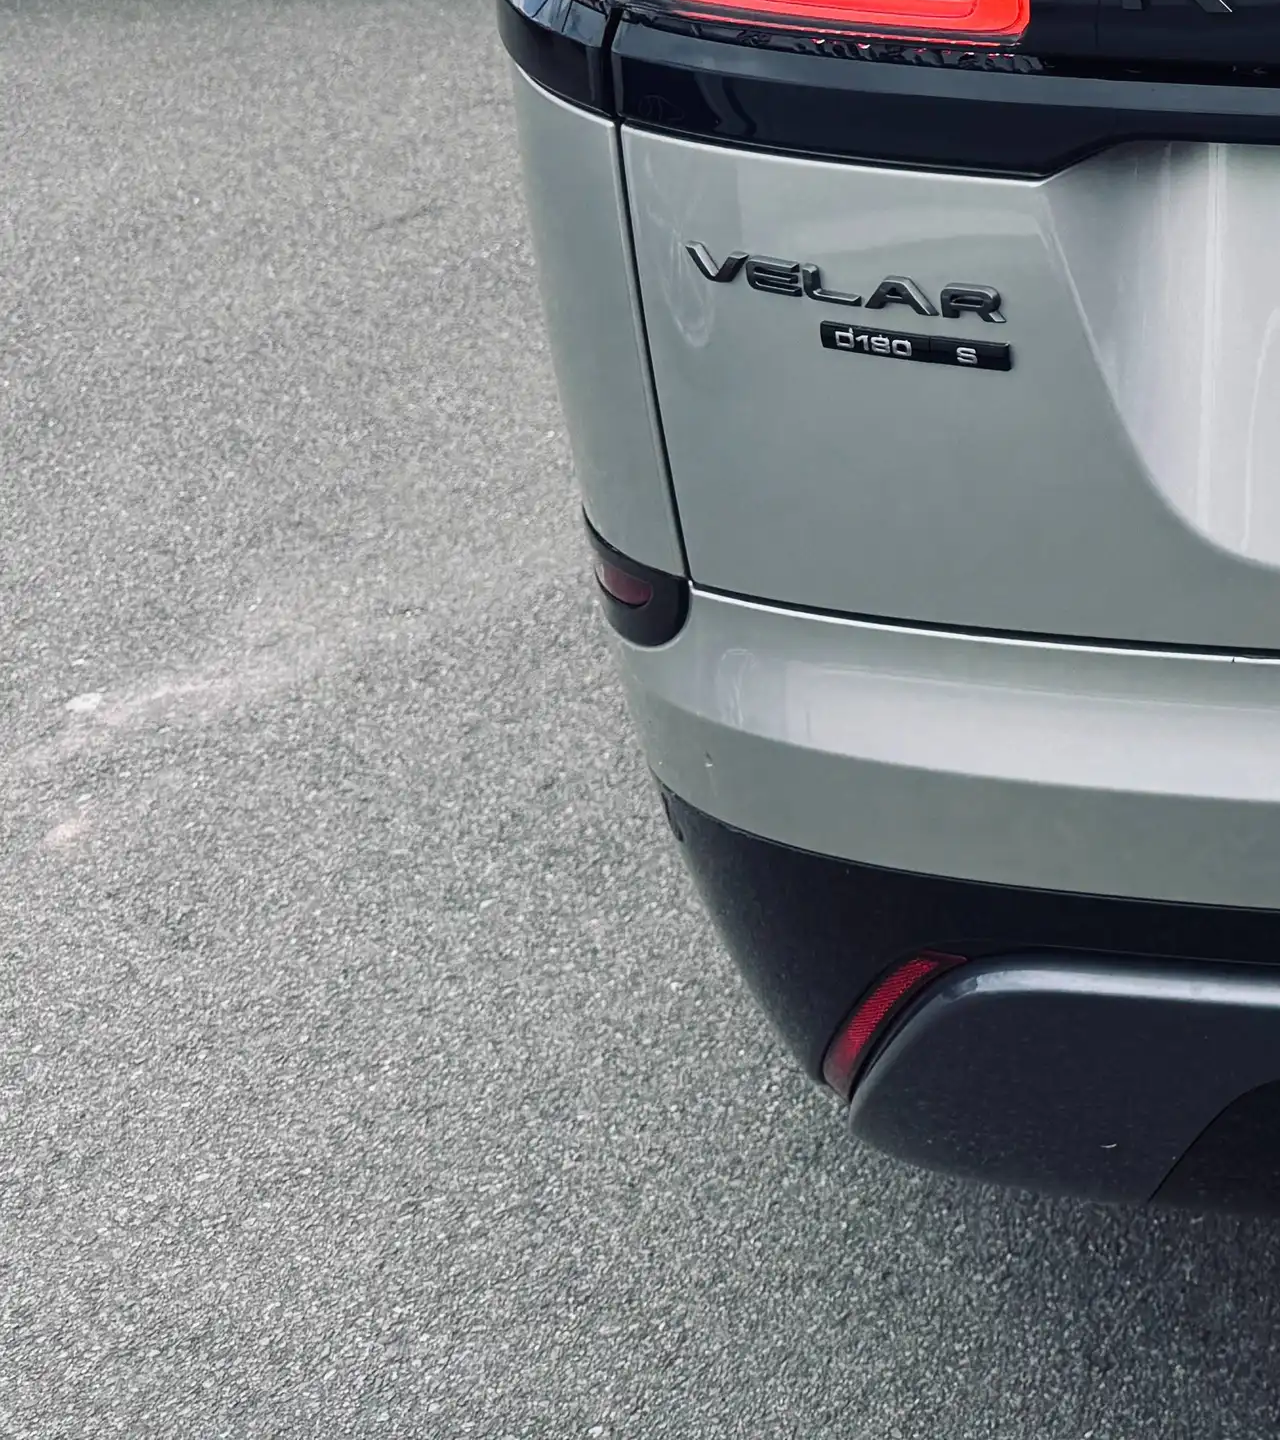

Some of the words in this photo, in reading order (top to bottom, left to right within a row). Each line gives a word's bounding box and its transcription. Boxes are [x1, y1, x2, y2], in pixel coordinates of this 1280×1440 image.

[685, 240, 1006, 323] VELAR
[834, 327, 912, 358] D180
[956, 346, 978, 365] S
